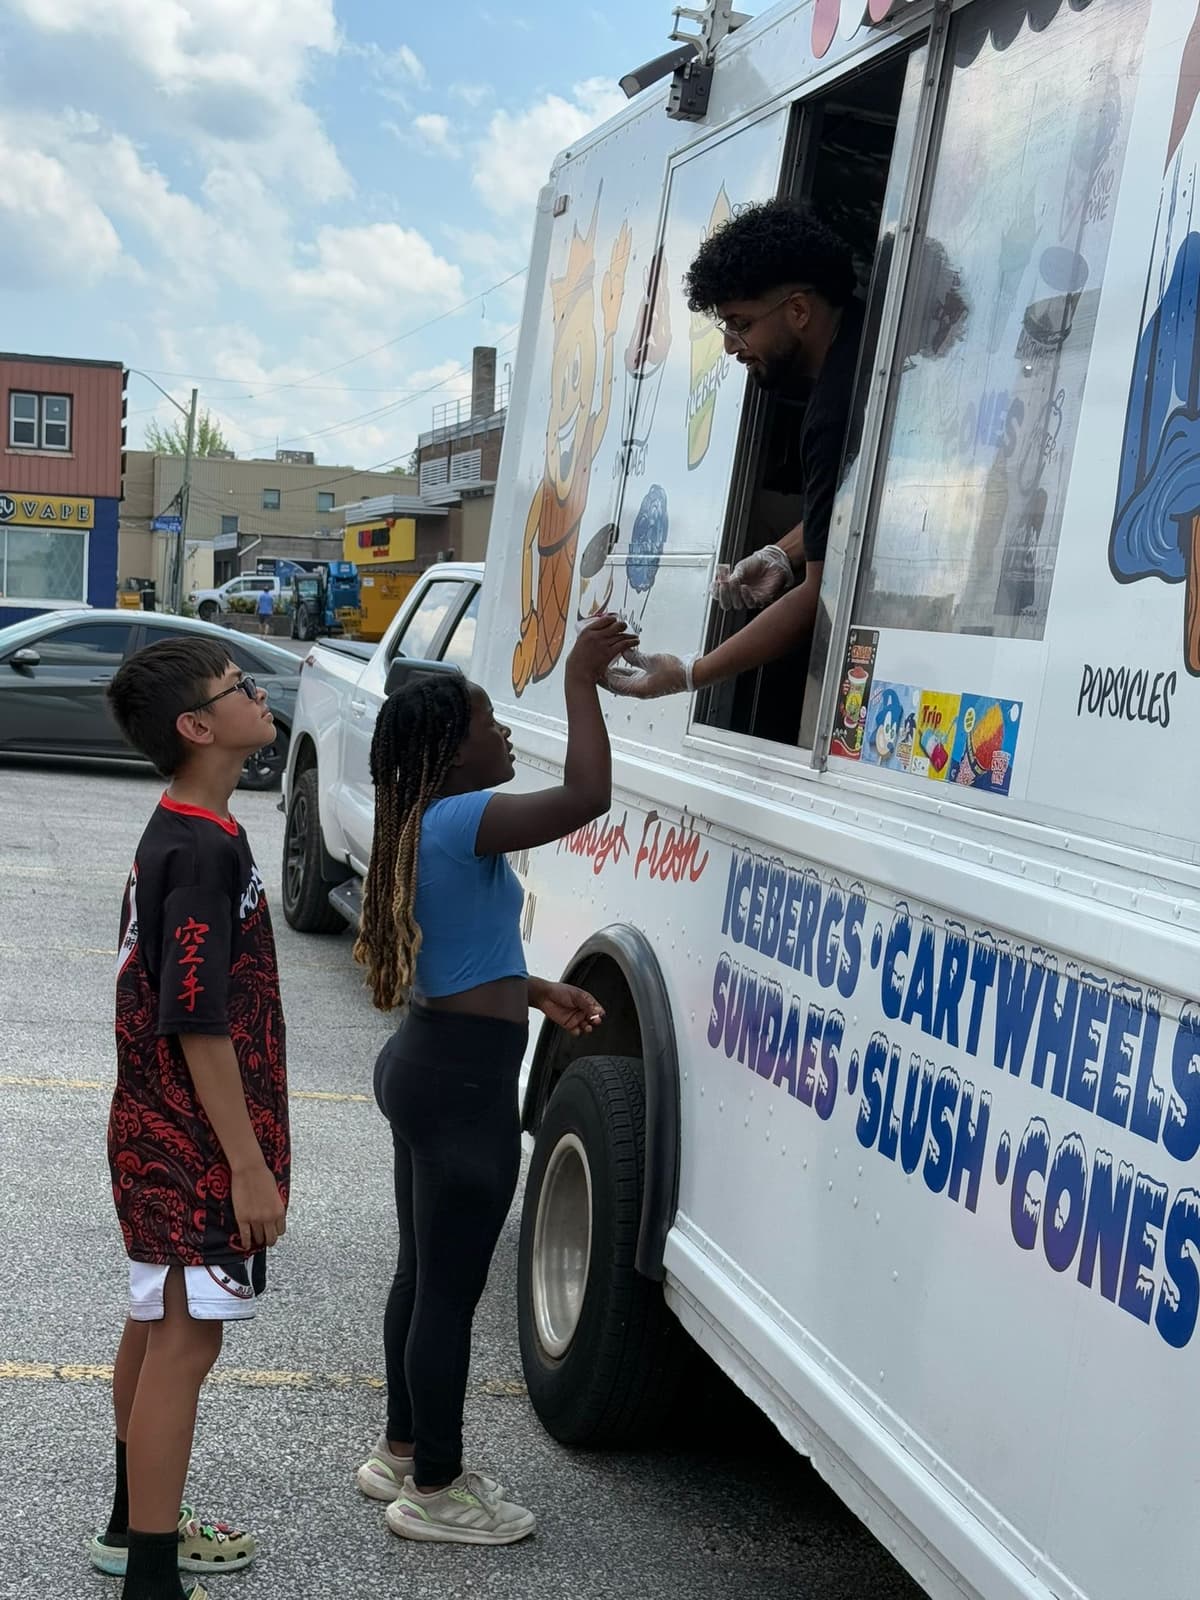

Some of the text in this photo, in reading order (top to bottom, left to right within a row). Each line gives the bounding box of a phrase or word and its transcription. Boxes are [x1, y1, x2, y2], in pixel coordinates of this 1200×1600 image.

[684, 352, 730, 428] ICEBERG
[22, 501, 90, 521] VAPE
[922, 705, 942, 728] Trip
[1077, 663, 1177, 729] POPSICLES
[634, 811, 709, 883] Fresh
[721, 843, 1200, 1162] ICEBERGS CARTWHEELS
[707, 951, 1200, 1349] SUNDAES SLUSH CONES
